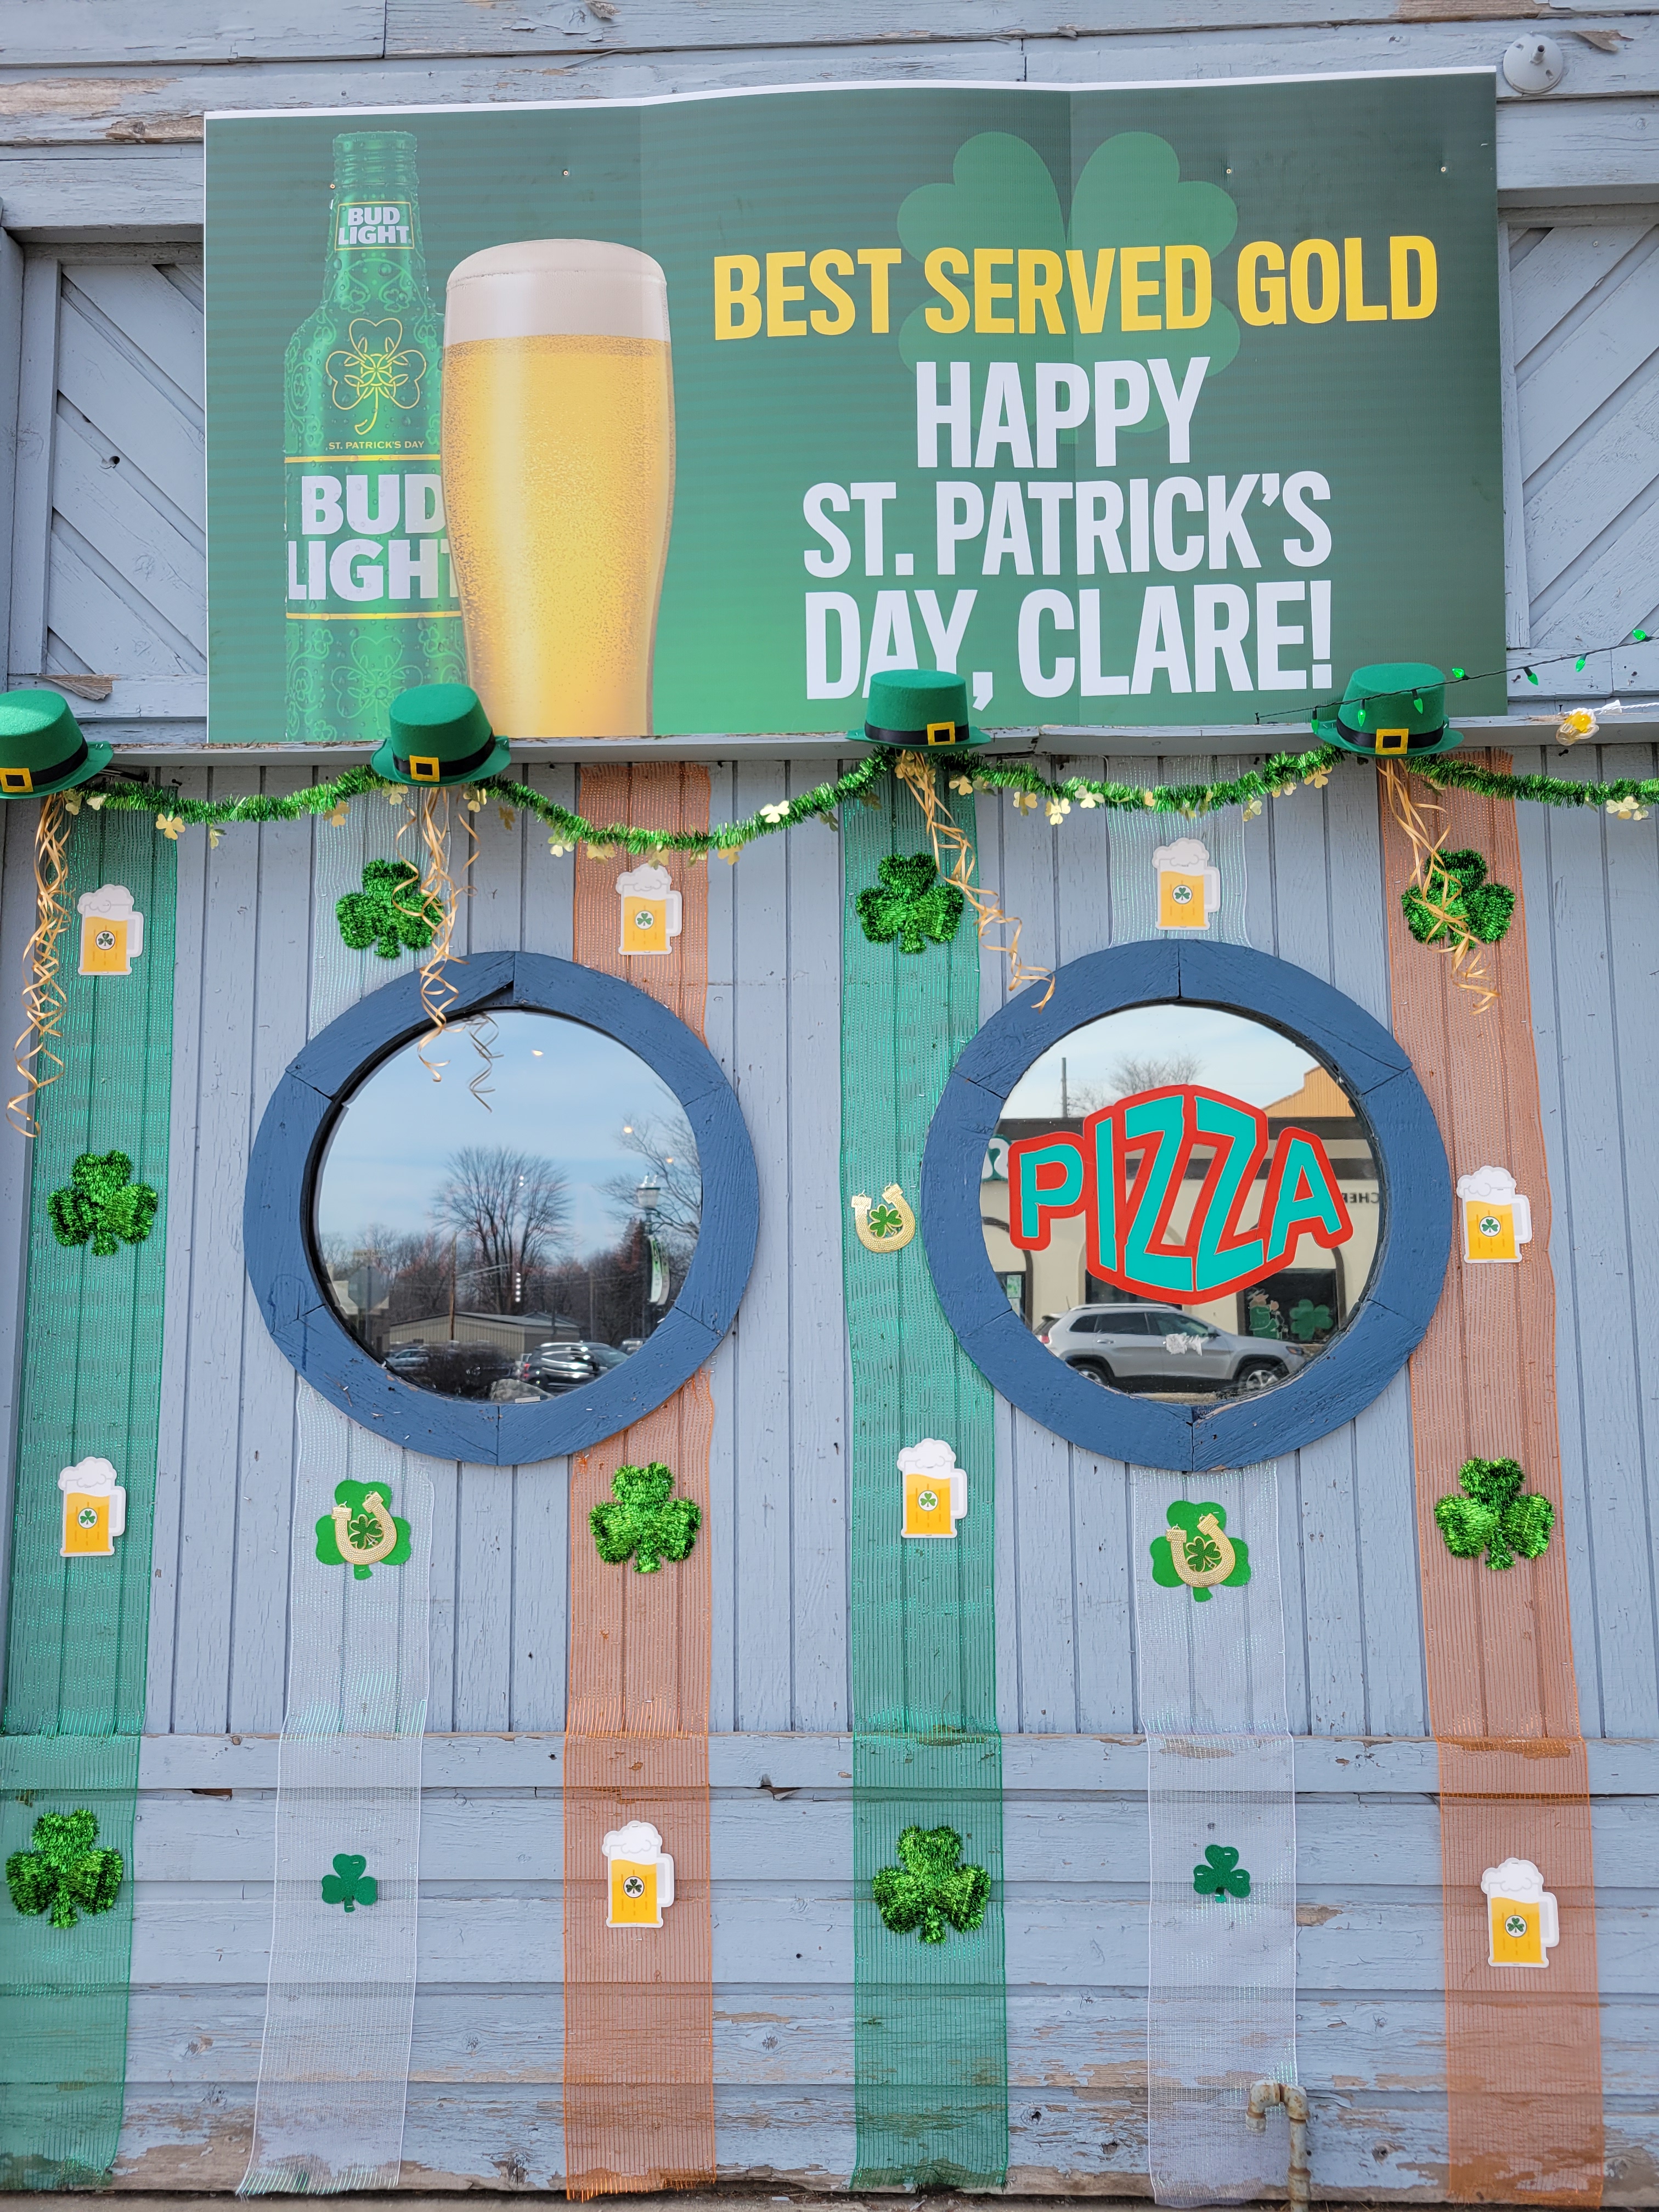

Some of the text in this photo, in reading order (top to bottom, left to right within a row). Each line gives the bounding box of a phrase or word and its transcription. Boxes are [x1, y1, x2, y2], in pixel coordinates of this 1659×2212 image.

[338, 225, 409, 245] LIGHT
[347, 207, 400, 226] BUD
[715, 235, 1437, 340] BEST SERVED GOLD
[917, 357, 1210, 469] HAPPY
[302, 474, 447, 534] BUD
[803, 471, 1332, 578] ST. PATRICK'S
[805, 580, 1332, 712] DAY, CLARE!
[1009, 1085, 1353, 1305] PIZZA
